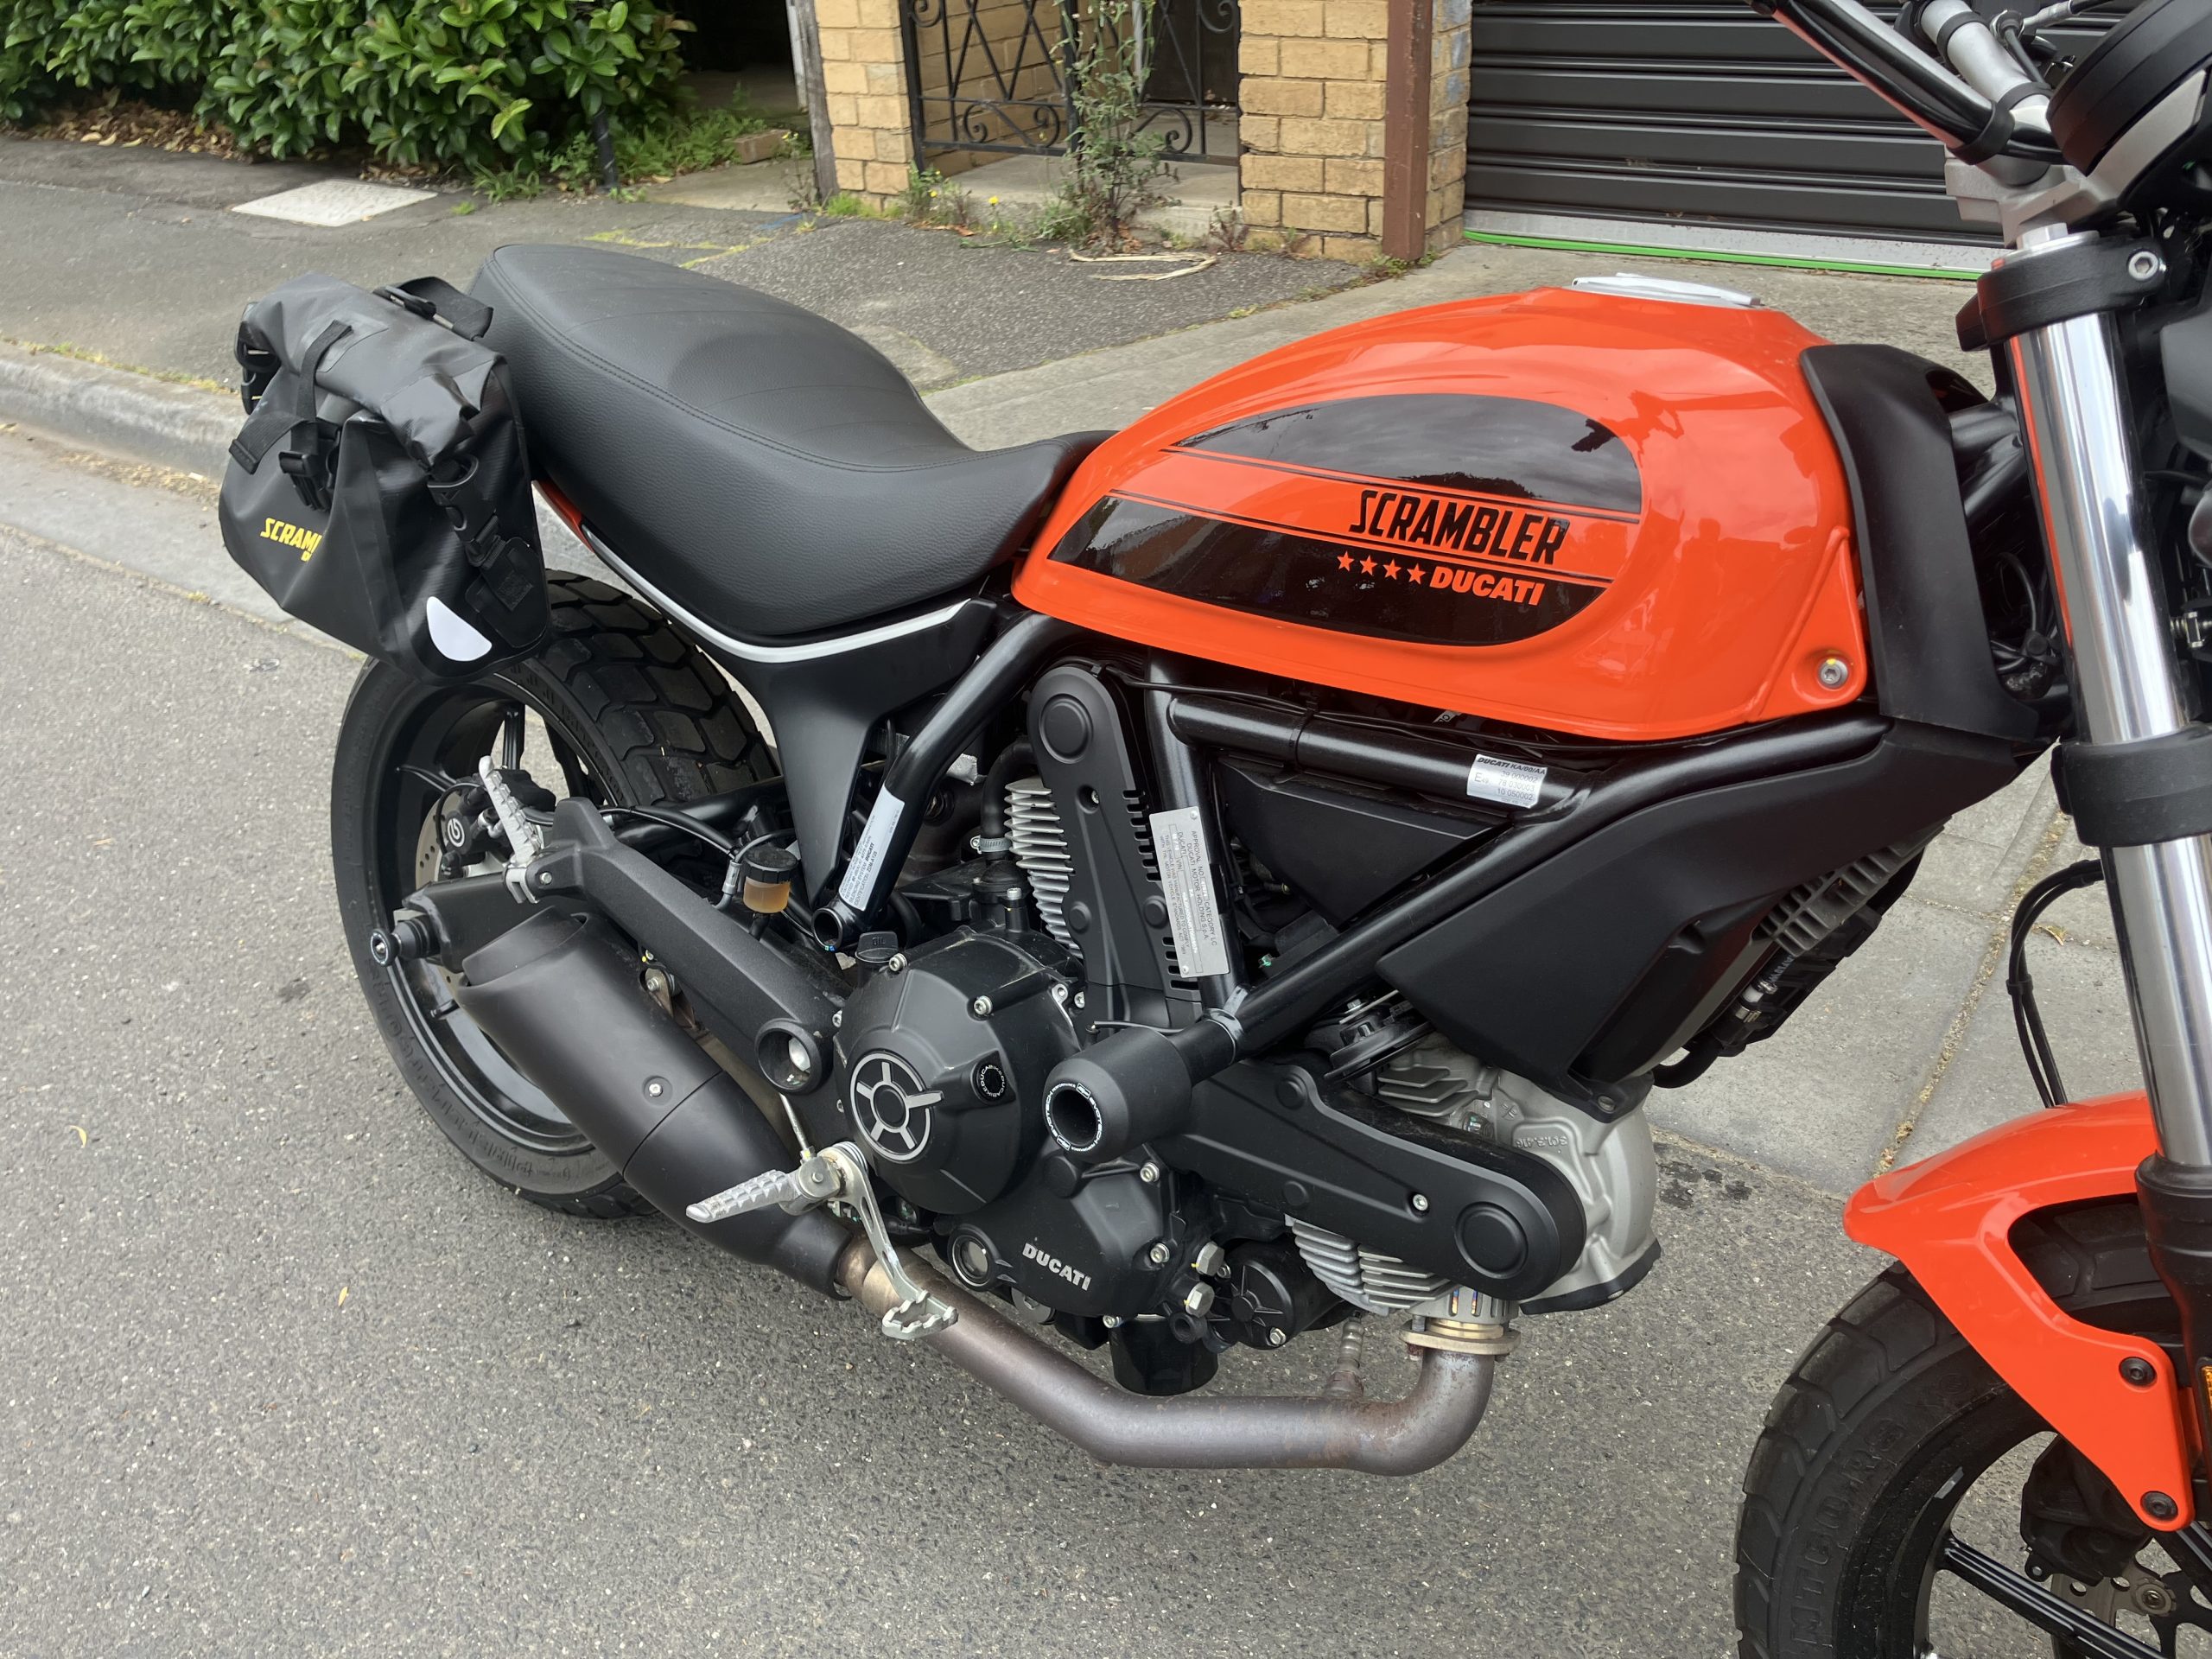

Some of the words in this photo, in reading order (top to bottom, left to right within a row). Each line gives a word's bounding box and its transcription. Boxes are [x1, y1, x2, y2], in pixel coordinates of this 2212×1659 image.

[1349, 490, 1570, 565] SCRAMBLER
[1429, 566, 1546, 606] DUCATI
[1477, 757, 1510, 767] DUCATI
[865, 842, 874, 861] DUCATI
[1176, 830, 1186, 855] DUCATI
[1185, 842, 1195, 866] DUCATI
[1190, 868, 1200, 892] MOTOR
[1195, 893, 1206, 922] HOLDING
[1190, 830, 1202, 862] APPROVAL
[1197, 865, 1205, 876] NO
[1203, 901, 1215, 936] CATEGORY
[1210, 937, 1217, 946] LC
[1022, 1243, 1092, 1291] DUCATI
